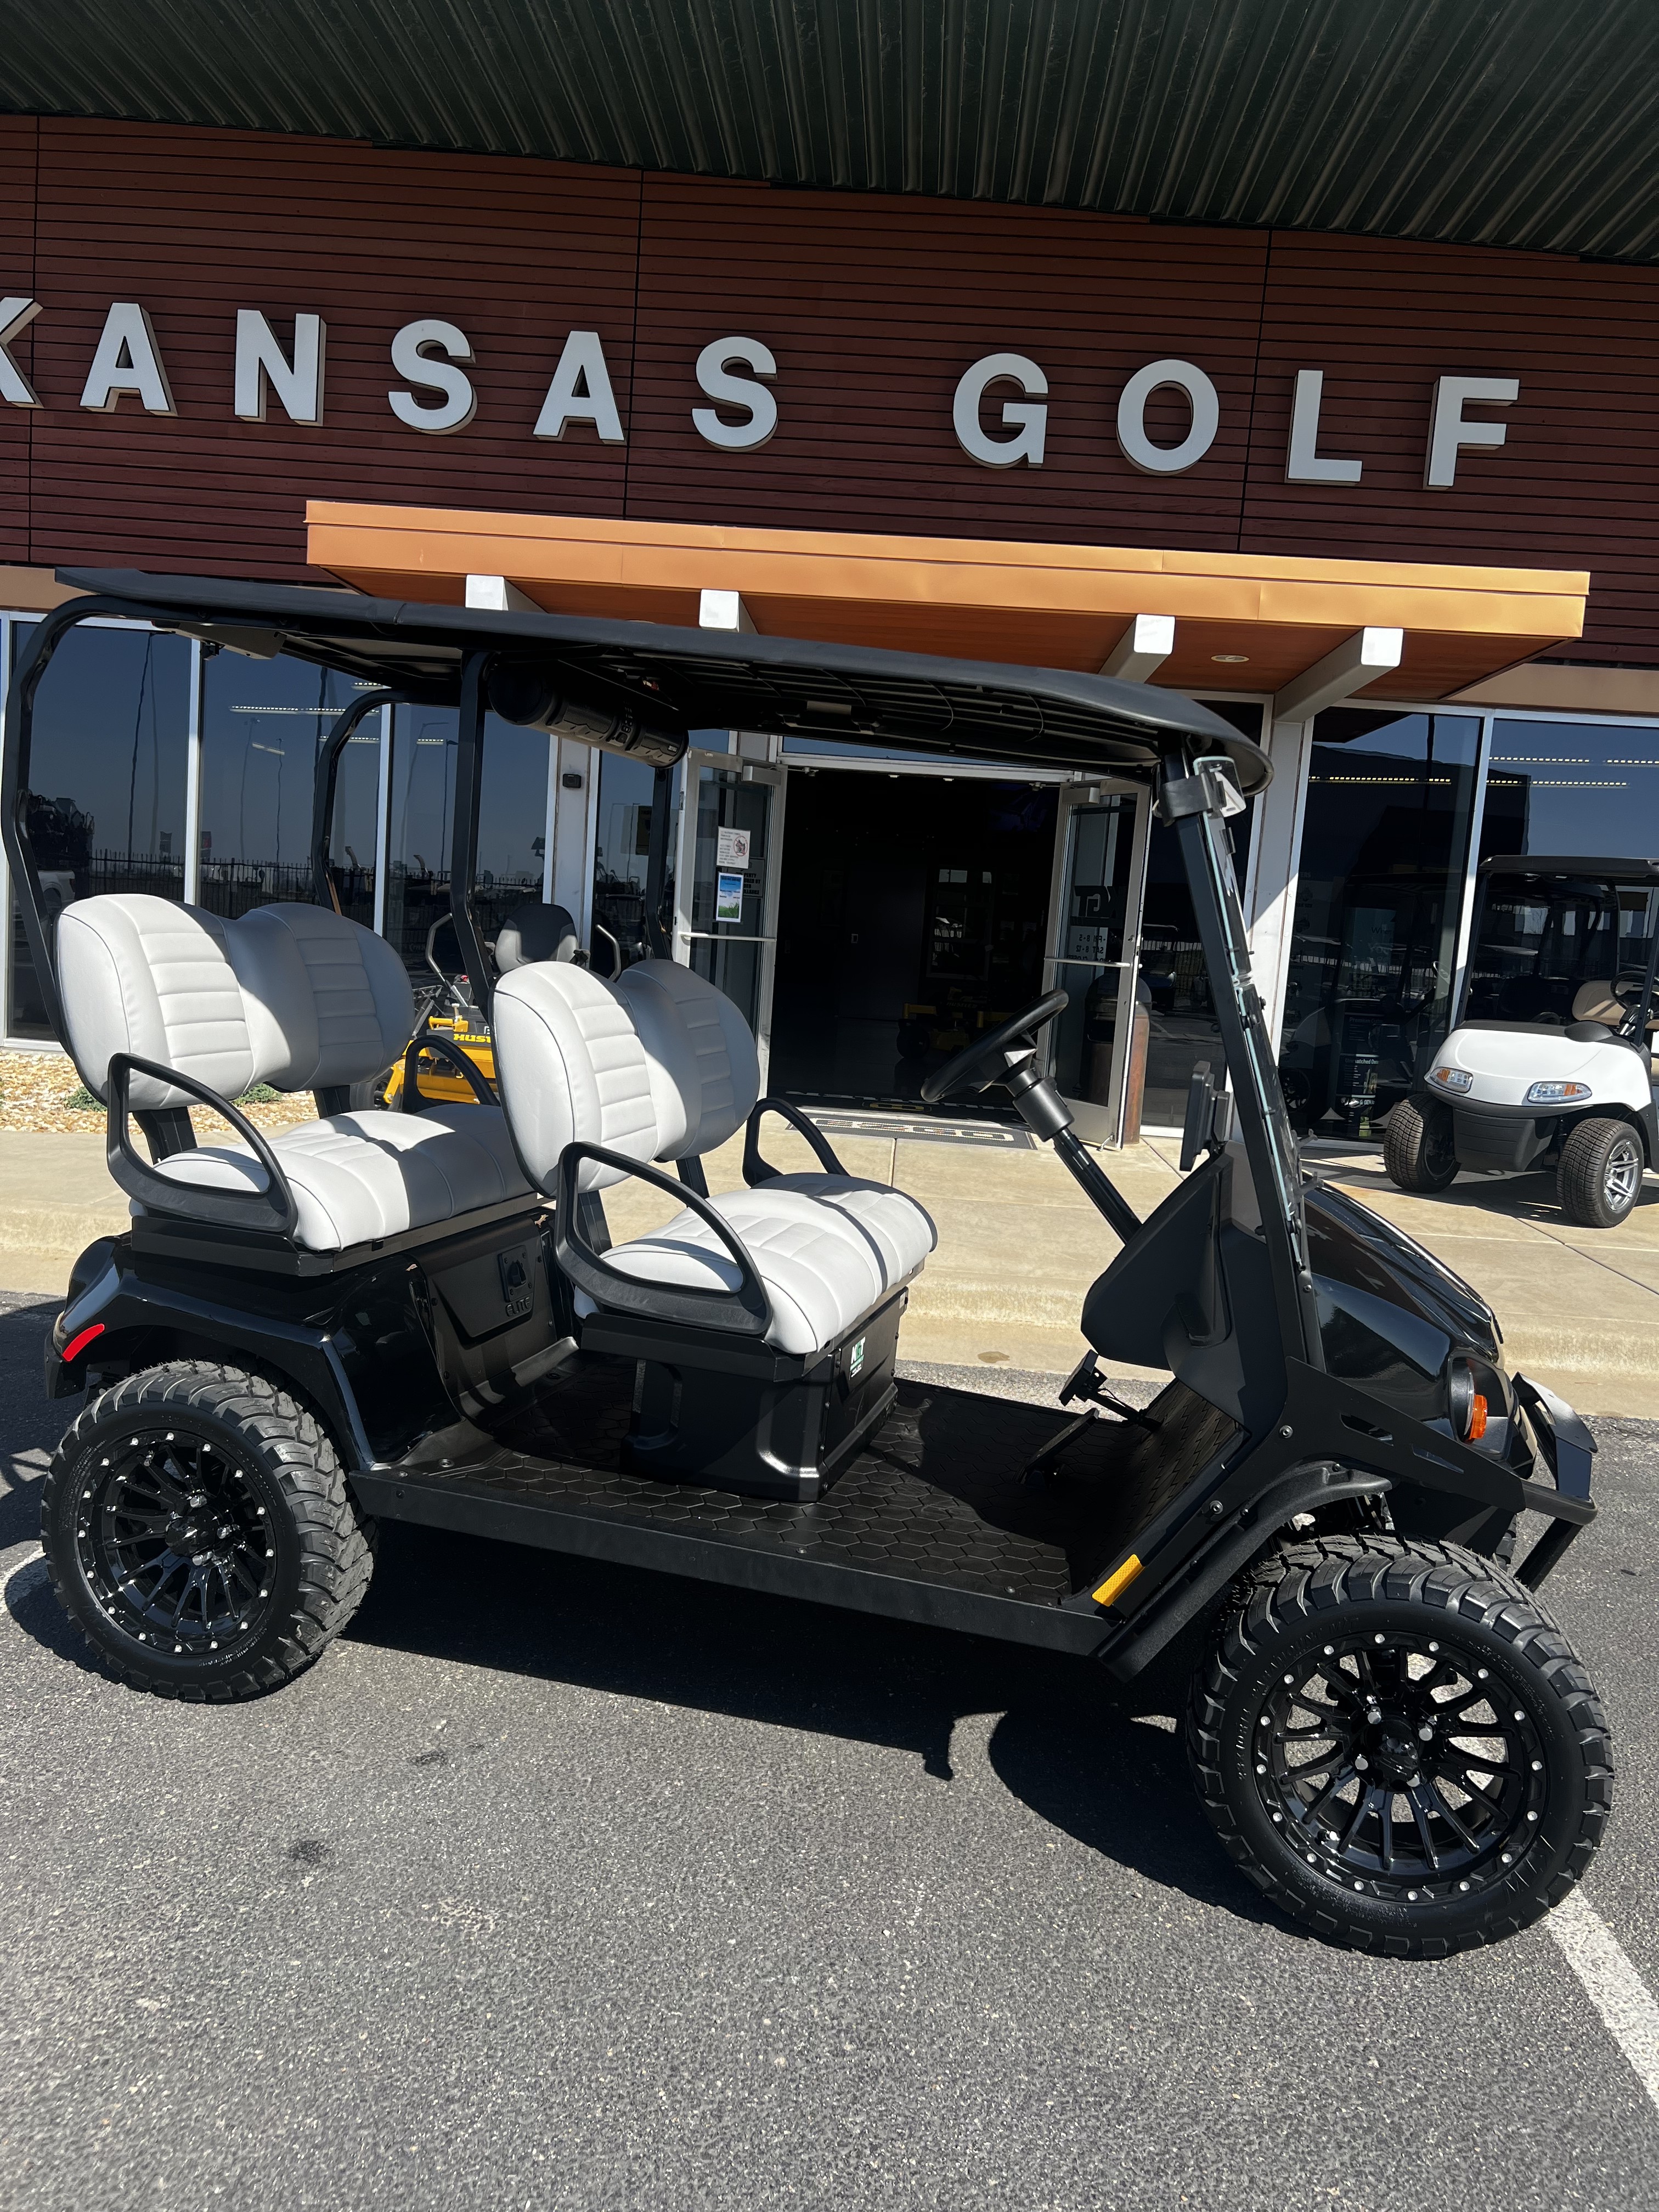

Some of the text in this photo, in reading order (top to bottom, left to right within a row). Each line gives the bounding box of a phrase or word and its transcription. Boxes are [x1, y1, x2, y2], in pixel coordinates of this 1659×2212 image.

[952, 352, 1520, 489] GOLF
[454, 1034, 491, 1043] HUST
[505, 1296, 531, 1317] ELITE
